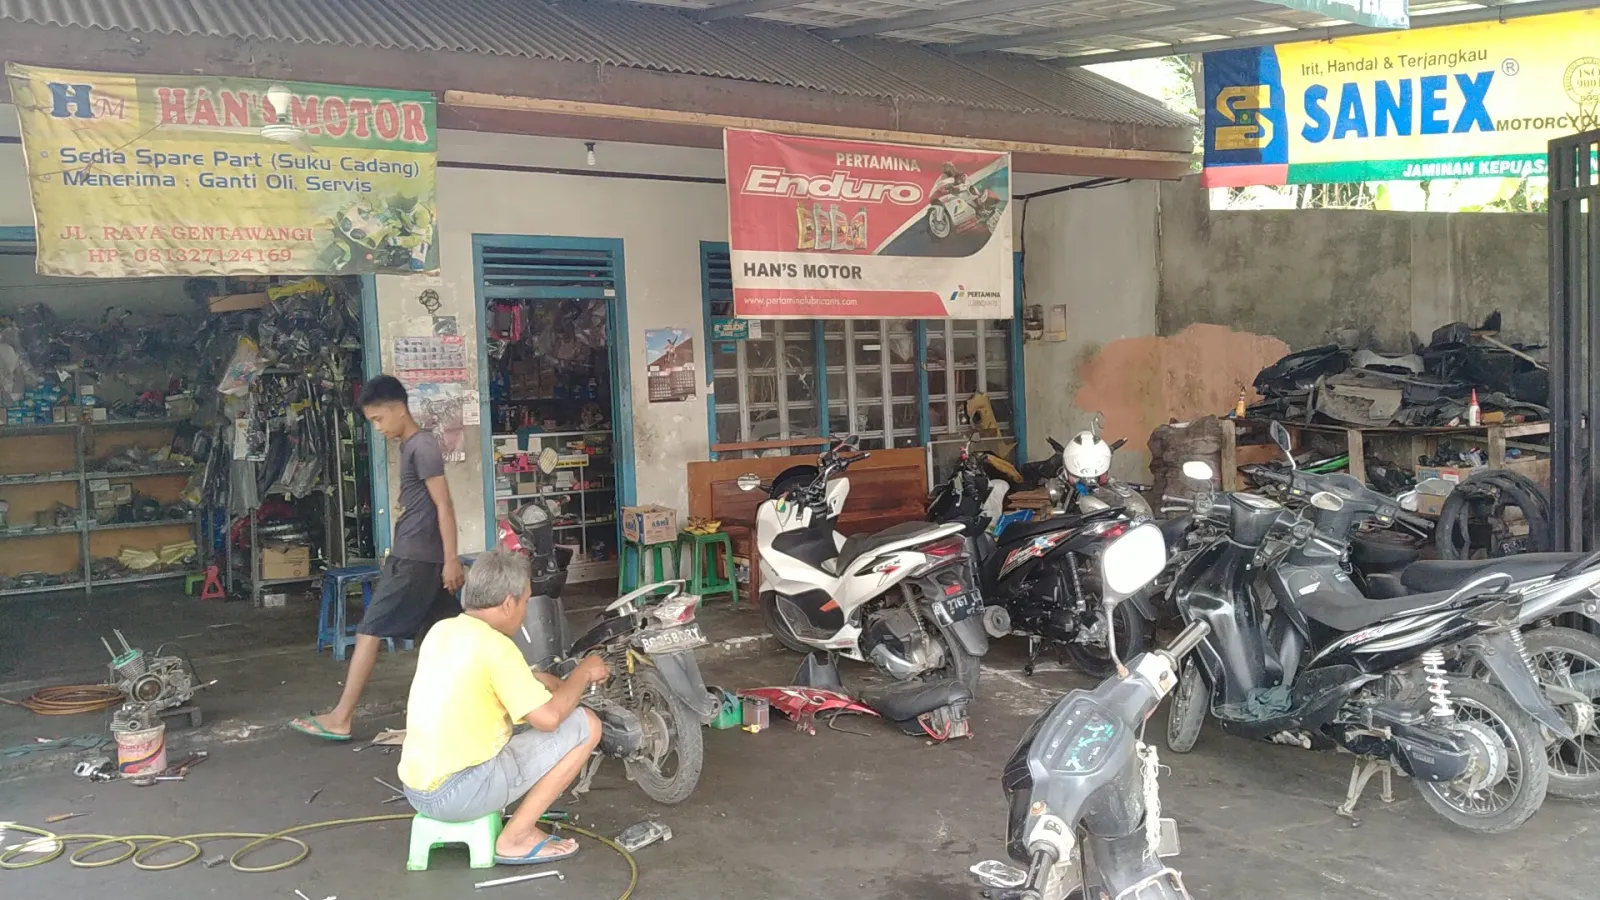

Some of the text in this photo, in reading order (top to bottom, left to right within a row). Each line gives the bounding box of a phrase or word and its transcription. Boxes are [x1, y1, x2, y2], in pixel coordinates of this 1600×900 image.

[1301, 49, 1487, 76] Irit, Handal & Terjangkau
[1301, 71, 1495, 143] SANEX
[292, 97, 428, 142] MOTOR
[60, 147, 421, 178] Sedia Spare Part (Suku Cadang)
[836, 152, 920, 172] PERTAMINA
[1403, 159, 1548, 178] JAMINAN KEPUAS
[63, 169, 176, 188] Menerima
[199, 172, 256, 190] Ganti
[305, 176, 372, 193] Servis
[741, 165, 923, 205] Enduro
[104, 227, 165, 241] RAYA
[171, 227, 313, 242] GENTAWANGI
[134, 248, 293, 262] 081327124169
[743, 262, 862, 279] HAN'S MOTOR
